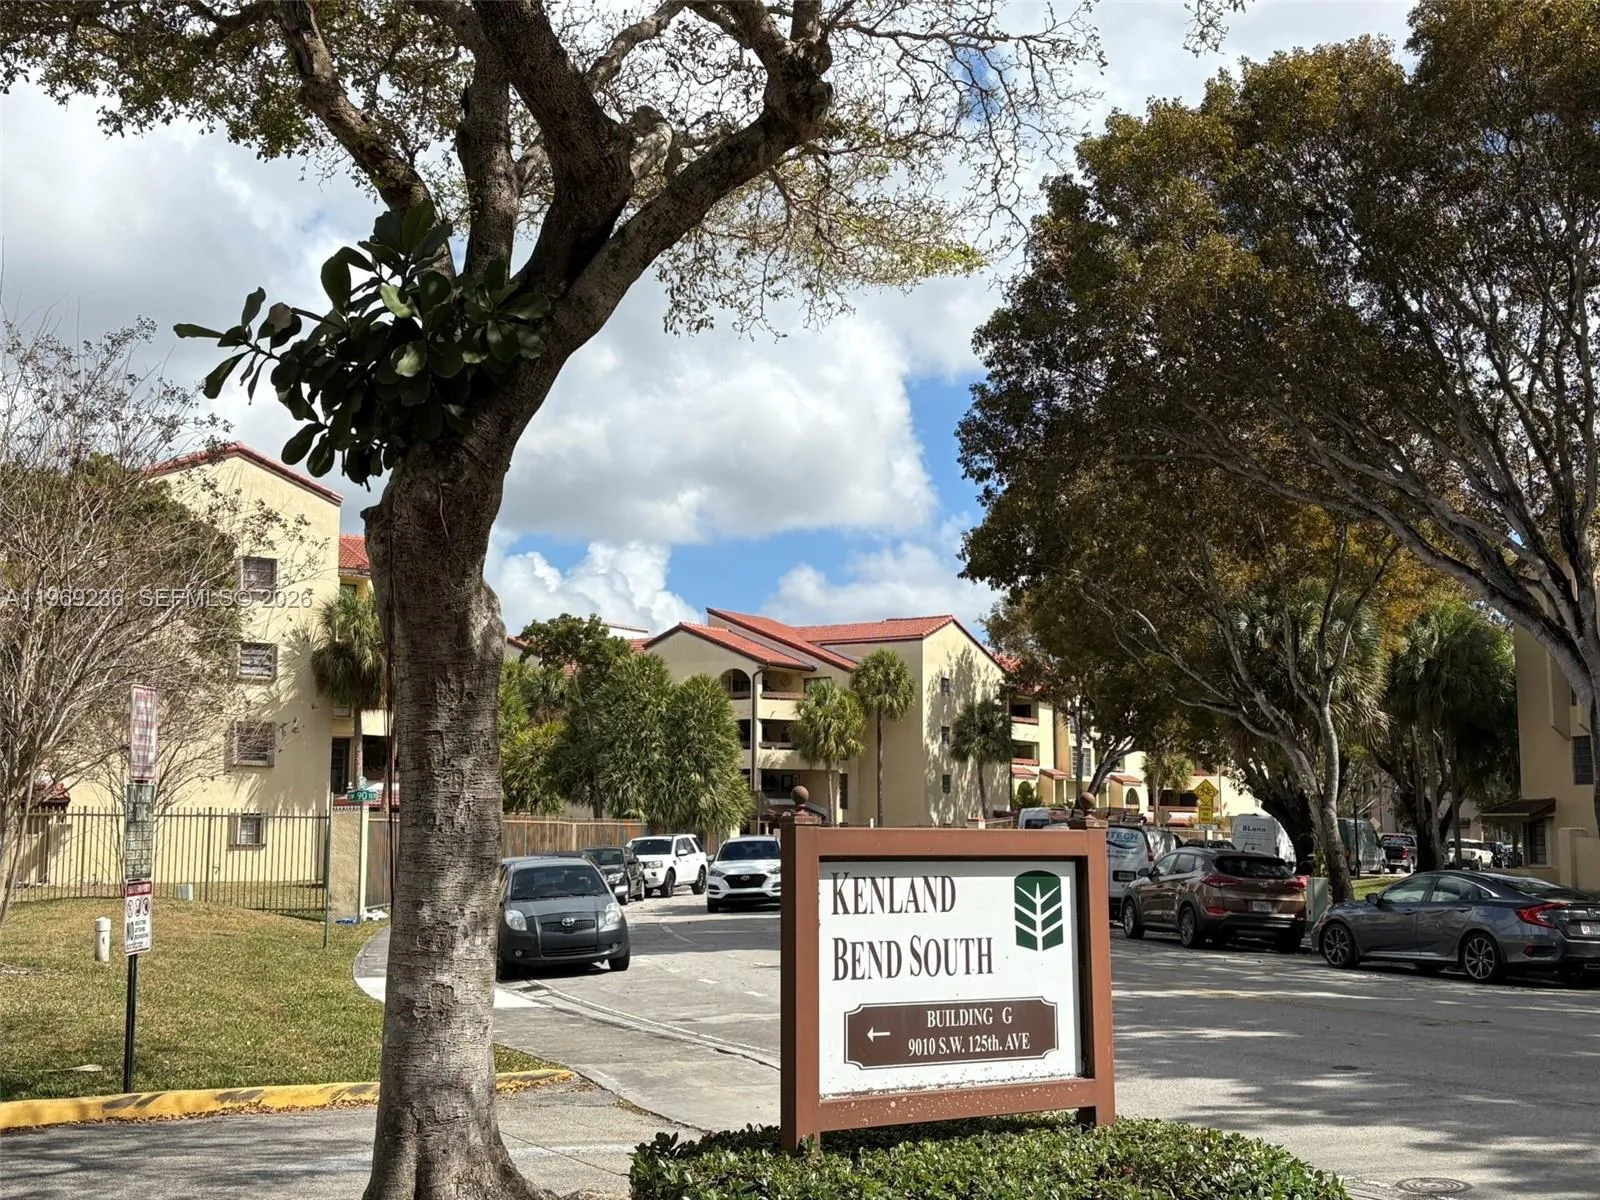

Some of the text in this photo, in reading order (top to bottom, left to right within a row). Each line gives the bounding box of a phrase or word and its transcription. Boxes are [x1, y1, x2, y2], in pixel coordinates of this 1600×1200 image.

[357, 791, 367, 800] 90
[1106, 831, 1139, 841] TECH
[831, 871, 957, 916] KENLAND
[832, 934, 994, 981] BEND SOUTH
[926, 1006, 1014, 1028] BUILDING G
[908, 1032, 1030, 1057] 9010 S.W. 125th. AVE
